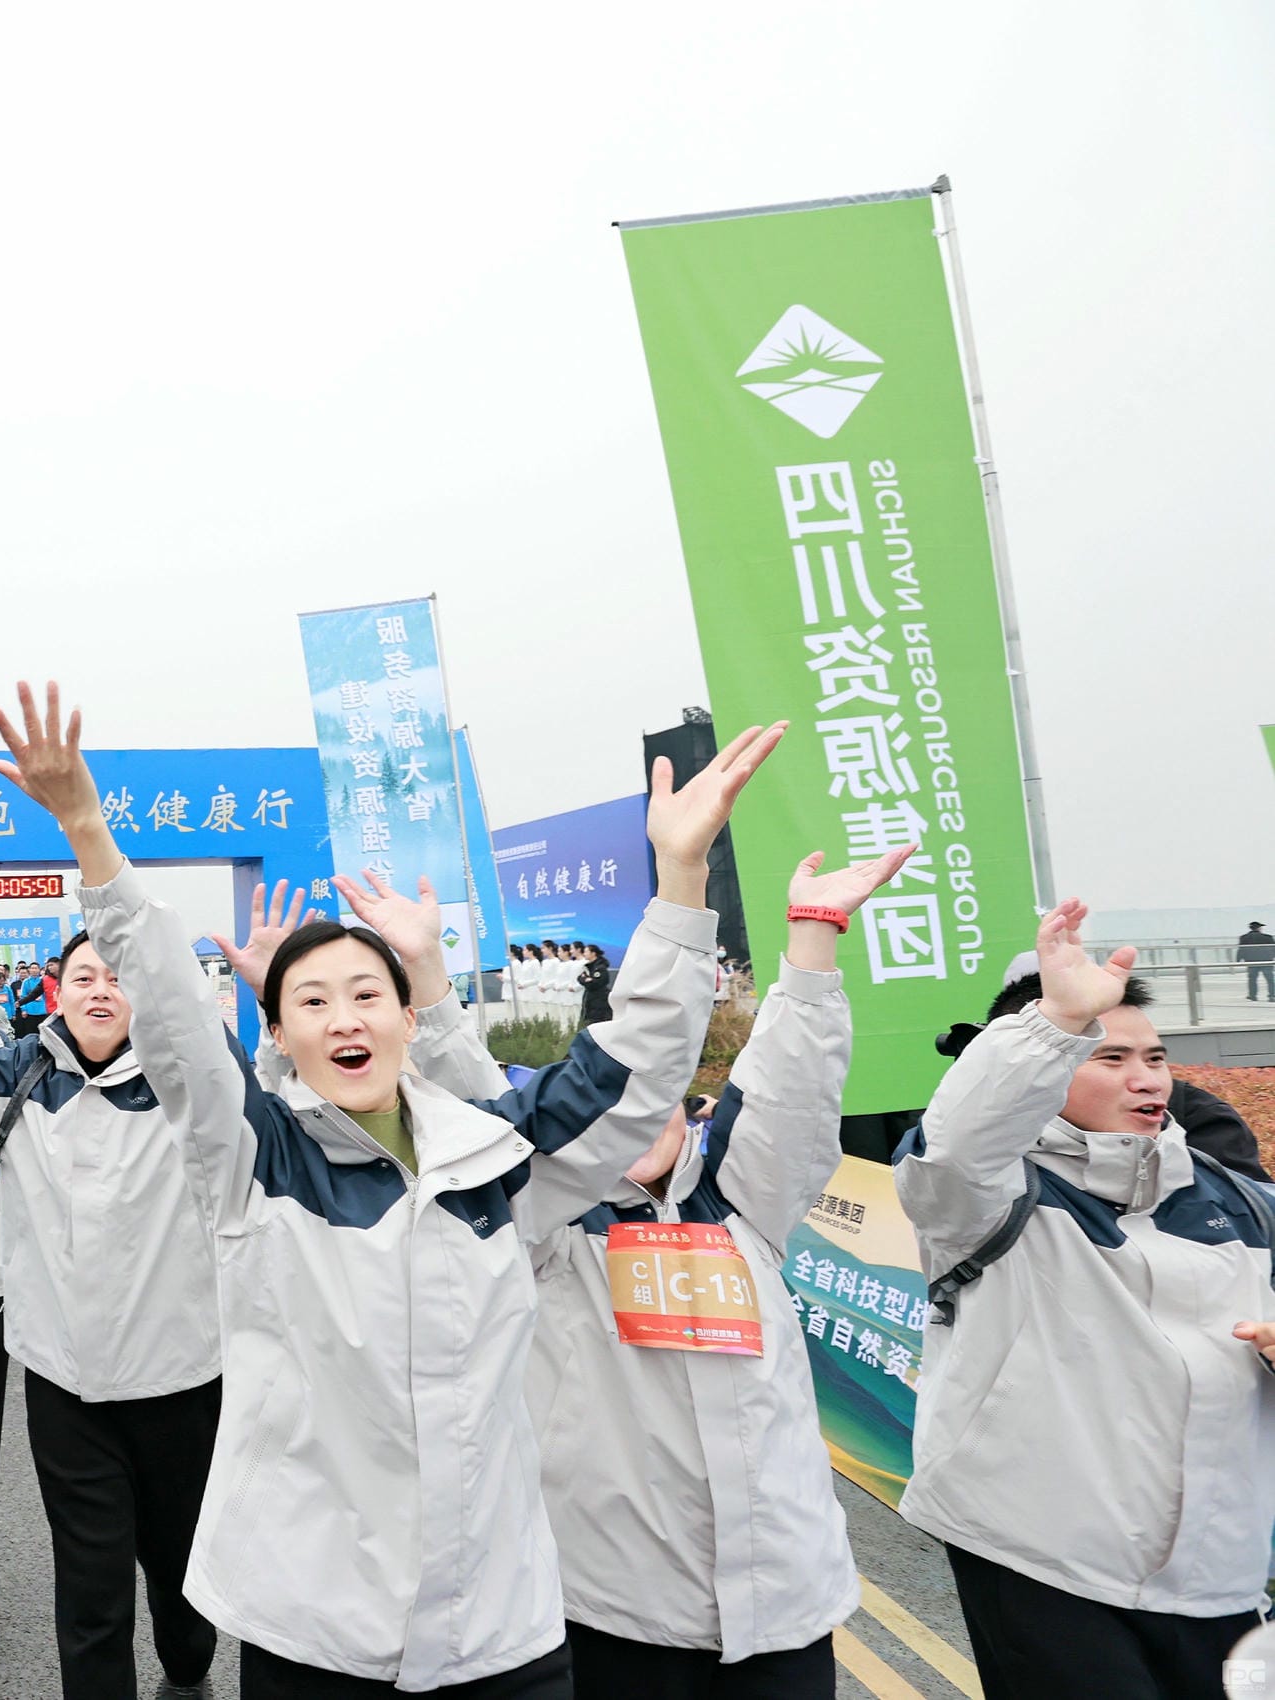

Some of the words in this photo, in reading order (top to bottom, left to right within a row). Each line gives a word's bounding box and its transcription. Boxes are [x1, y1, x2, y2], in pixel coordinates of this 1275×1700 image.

[50, 784, 294, 833] 然健康行
[517, 858, 618, 900] 自然健康行
[669, 1271, 753, 1307] C-131
[790, 1293, 925, 1388] 省自然资
